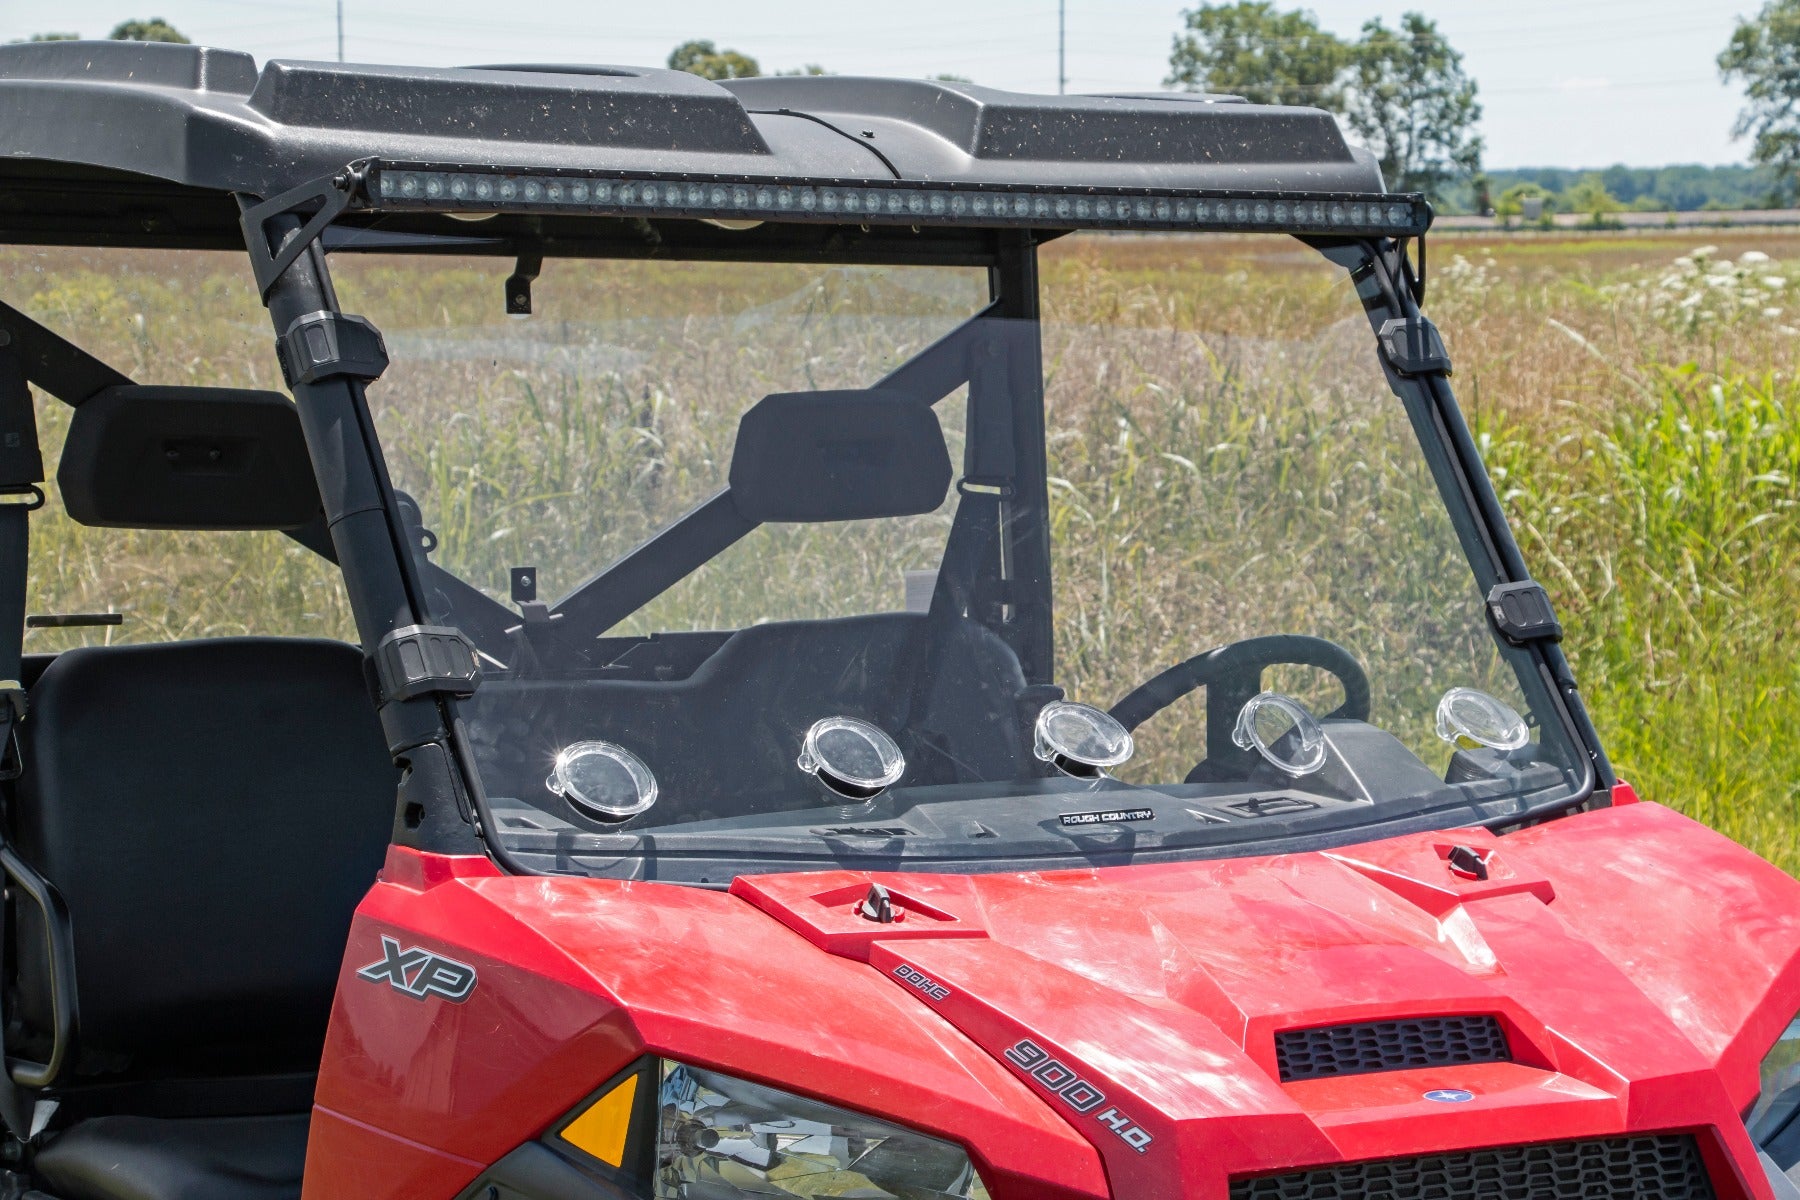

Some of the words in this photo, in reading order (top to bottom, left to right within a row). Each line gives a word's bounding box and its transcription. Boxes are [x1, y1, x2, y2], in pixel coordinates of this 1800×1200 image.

[1063, 814, 1100, 825] ROUGH
[1101, 810, 1152, 821] COUNTRY
[356, 933, 478, 1004] XP
[893, 963, 951, 1001] DOHC
[1003, 1037, 1106, 1113] 900
[1096, 1107, 1154, 1154] H.O.
